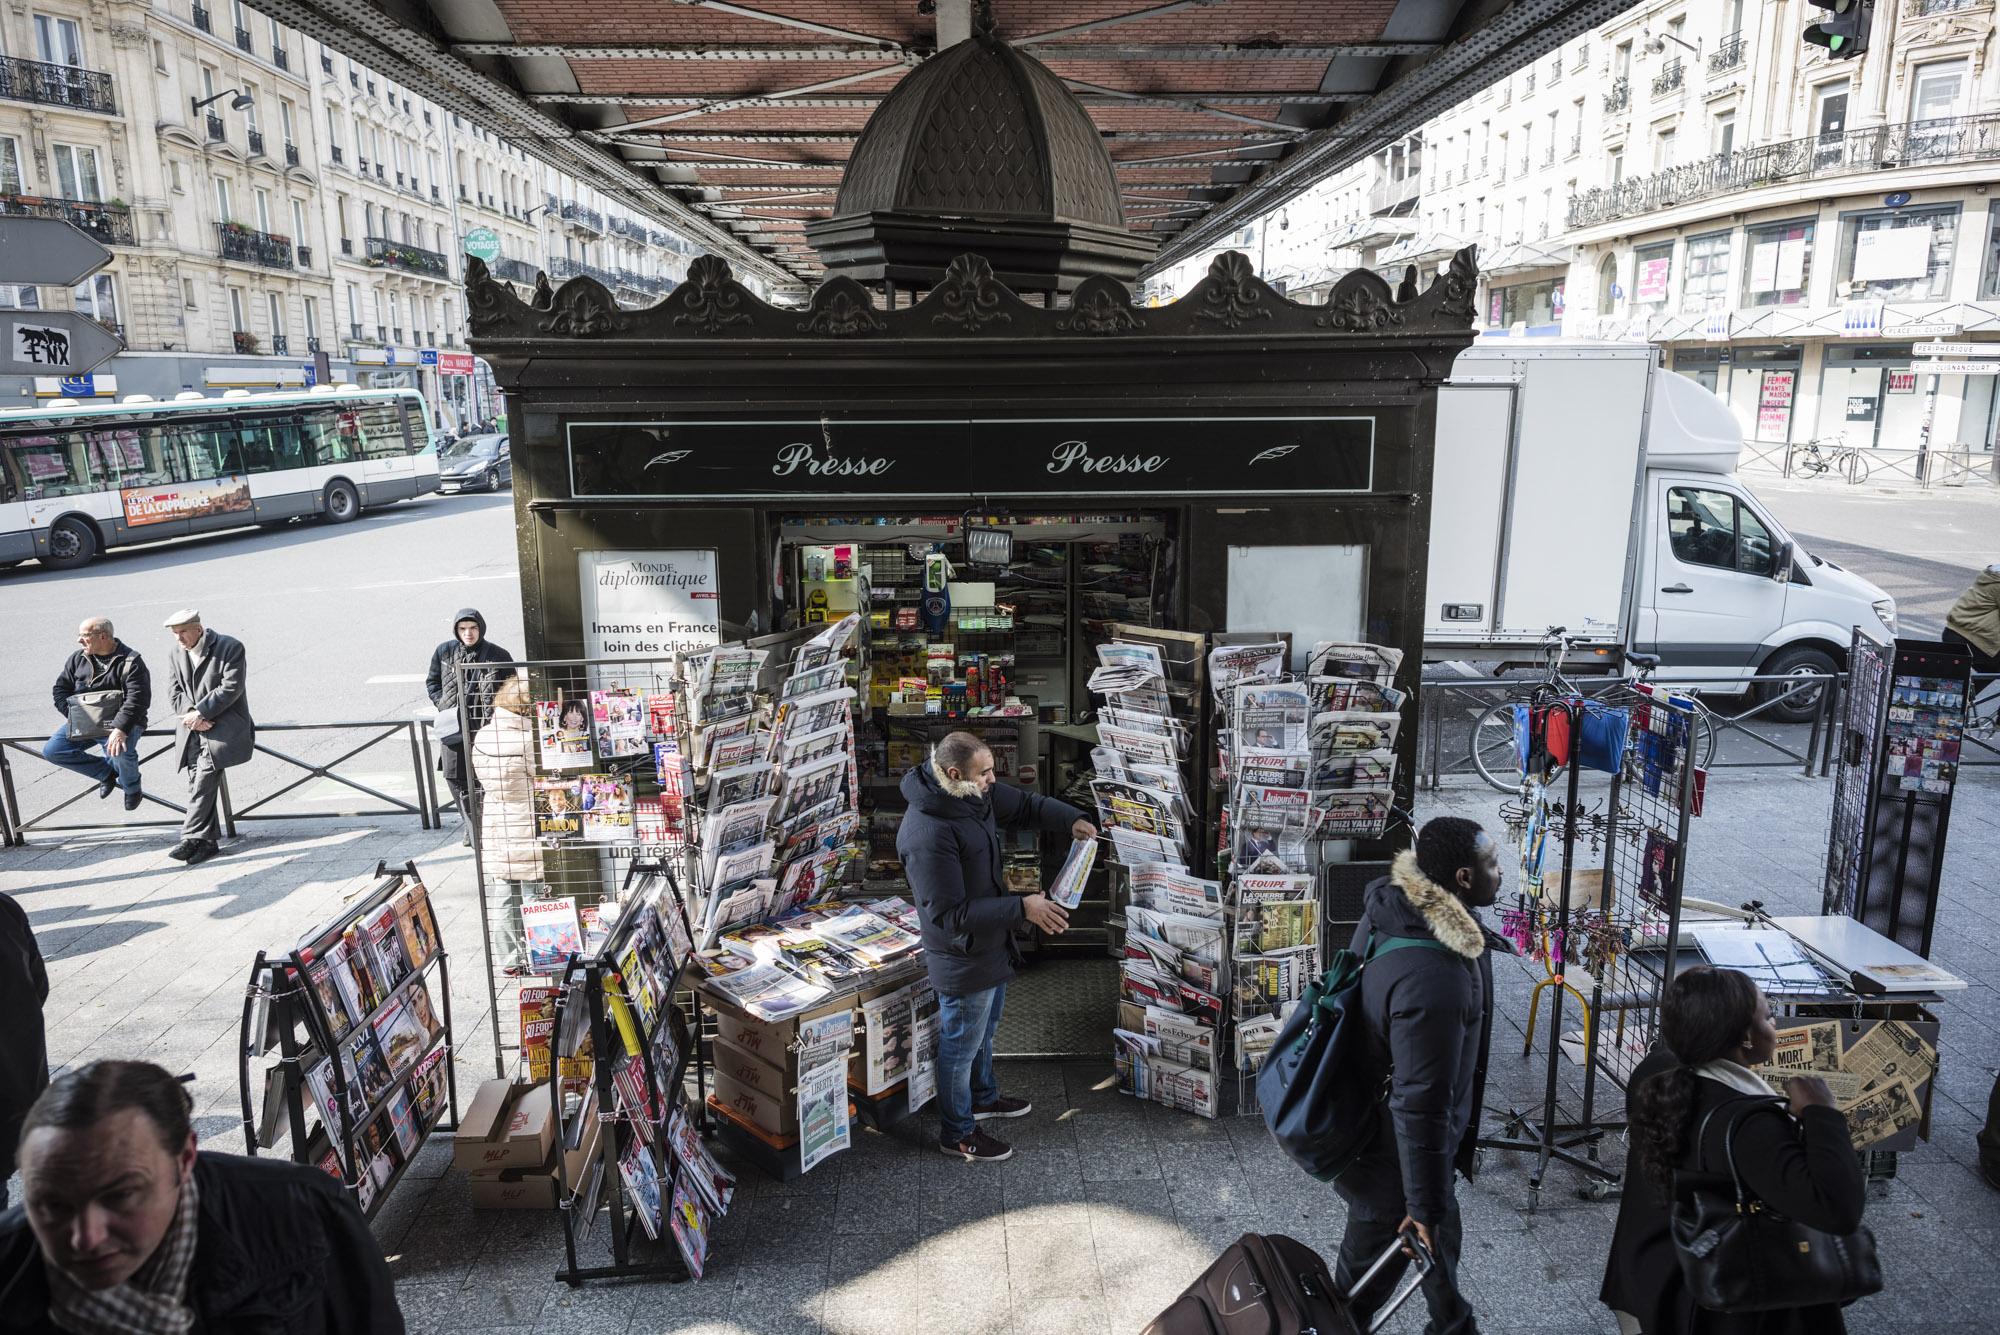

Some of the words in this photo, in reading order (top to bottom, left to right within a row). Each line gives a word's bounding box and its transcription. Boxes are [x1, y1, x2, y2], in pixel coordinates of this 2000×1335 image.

[1894, 194, 1901, 203] 2
[466, 241, 499, 250] VOYAGES
[1767, 376, 1793, 385] FEMME
[1889, 375, 1914, 389] TATI
[773, 442, 896, 476] Presse
[1047, 440, 1171, 474] Presse
[129, 506, 142, 516] DE
[143, 504, 155, 514] LA
[156, 495, 210, 513] CAPPADOCE
[137, 495, 155, 503] PAYS
[631, 562, 675, 573] MONDE
[599, 570, 708, 590] diplomatique
[592, 621, 642, 634] Imams
[647, 624, 663, 634] en
[668, 620, 717, 633] France
[604, 640, 630, 652] loin
[635, 640, 659, 652] des
[1274, 693, 1301, 704] Parisien
[1245, 756, 1286, 767] L'EQUIPE
[1257, 770, 1284, 778] GUERRE
[1259, 776, 1285, 784] CHEFS
[609, 846, 640, 859] une
[1243, 881, 1287, 889] L'EQUIPE
[1254, 892, 1286, 900] GUERRE
[522, 902, 570, 915] PARISCASA
[522, 990, 532, 1003] SO
[532, 988, 550, 1001] FOOT
[525, 1023, 535, 1038] SO
[535, 1022, 553, 1034] FOOT
[827, 1020, 850, 1033] Parisien
[1158, 1024, 1171, 1034] Les
[738, 1029, 762, 1050] MLP
[1777, 1048, 1804, 1066] MORT
[734, 1095, 758, 1117] MLP
[483, 1149, 510, 1162] MLP
[501, 1188, 525, 1200] MLP
